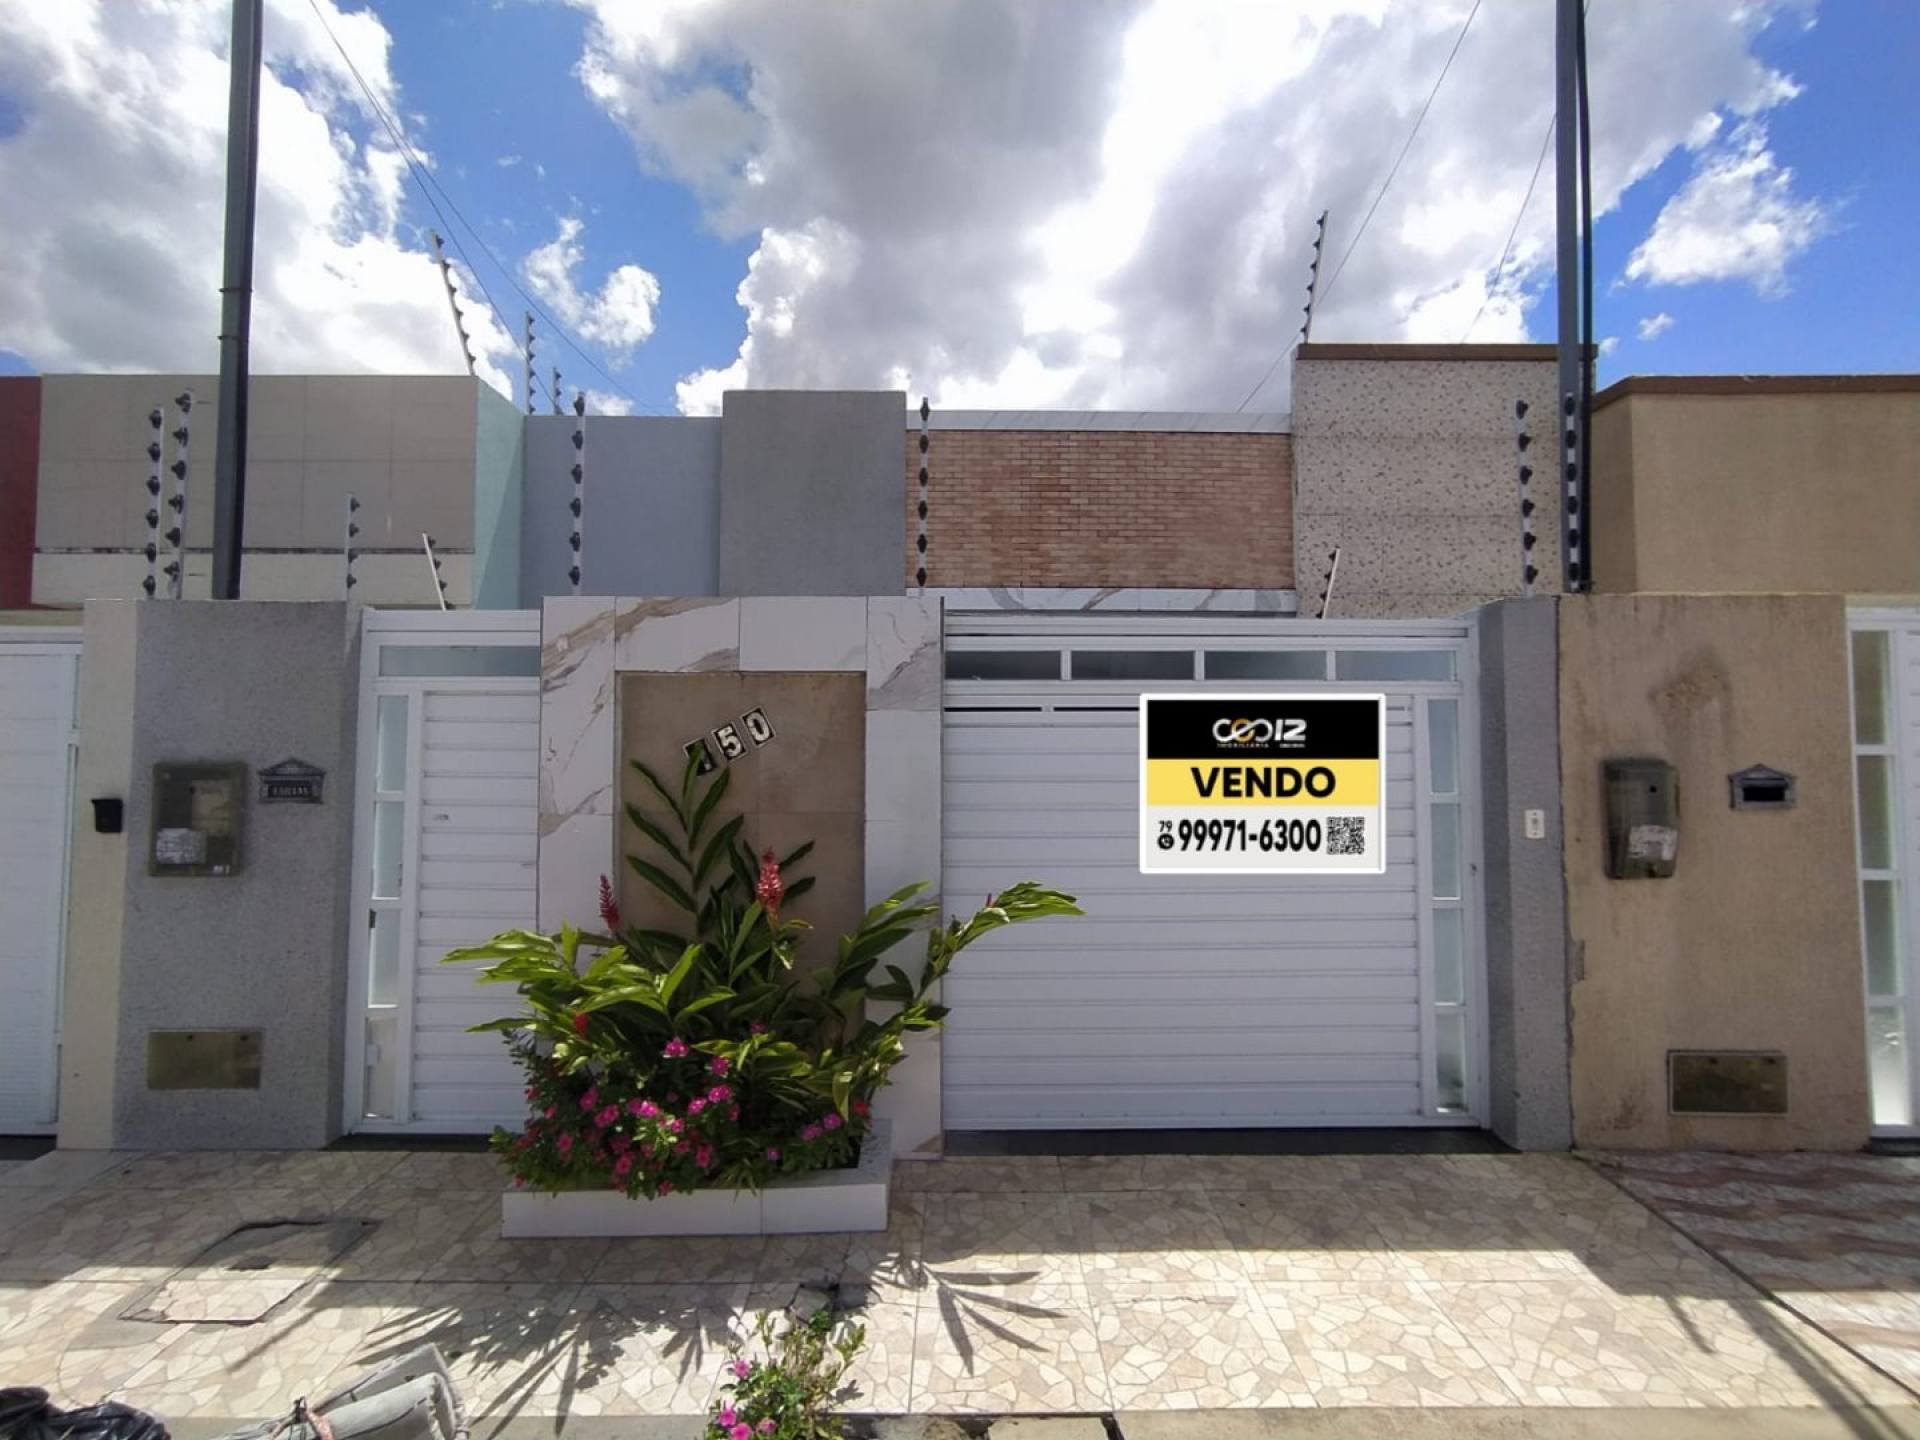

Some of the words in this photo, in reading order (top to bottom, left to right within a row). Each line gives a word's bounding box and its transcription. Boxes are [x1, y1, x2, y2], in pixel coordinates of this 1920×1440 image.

[688, 711, 771, 773] 50
[1191, 766, 1337, 798] VENDO
[1159, 820, 1173, 833] 79
[1178, 819, 1322, 852] 99971-6300
